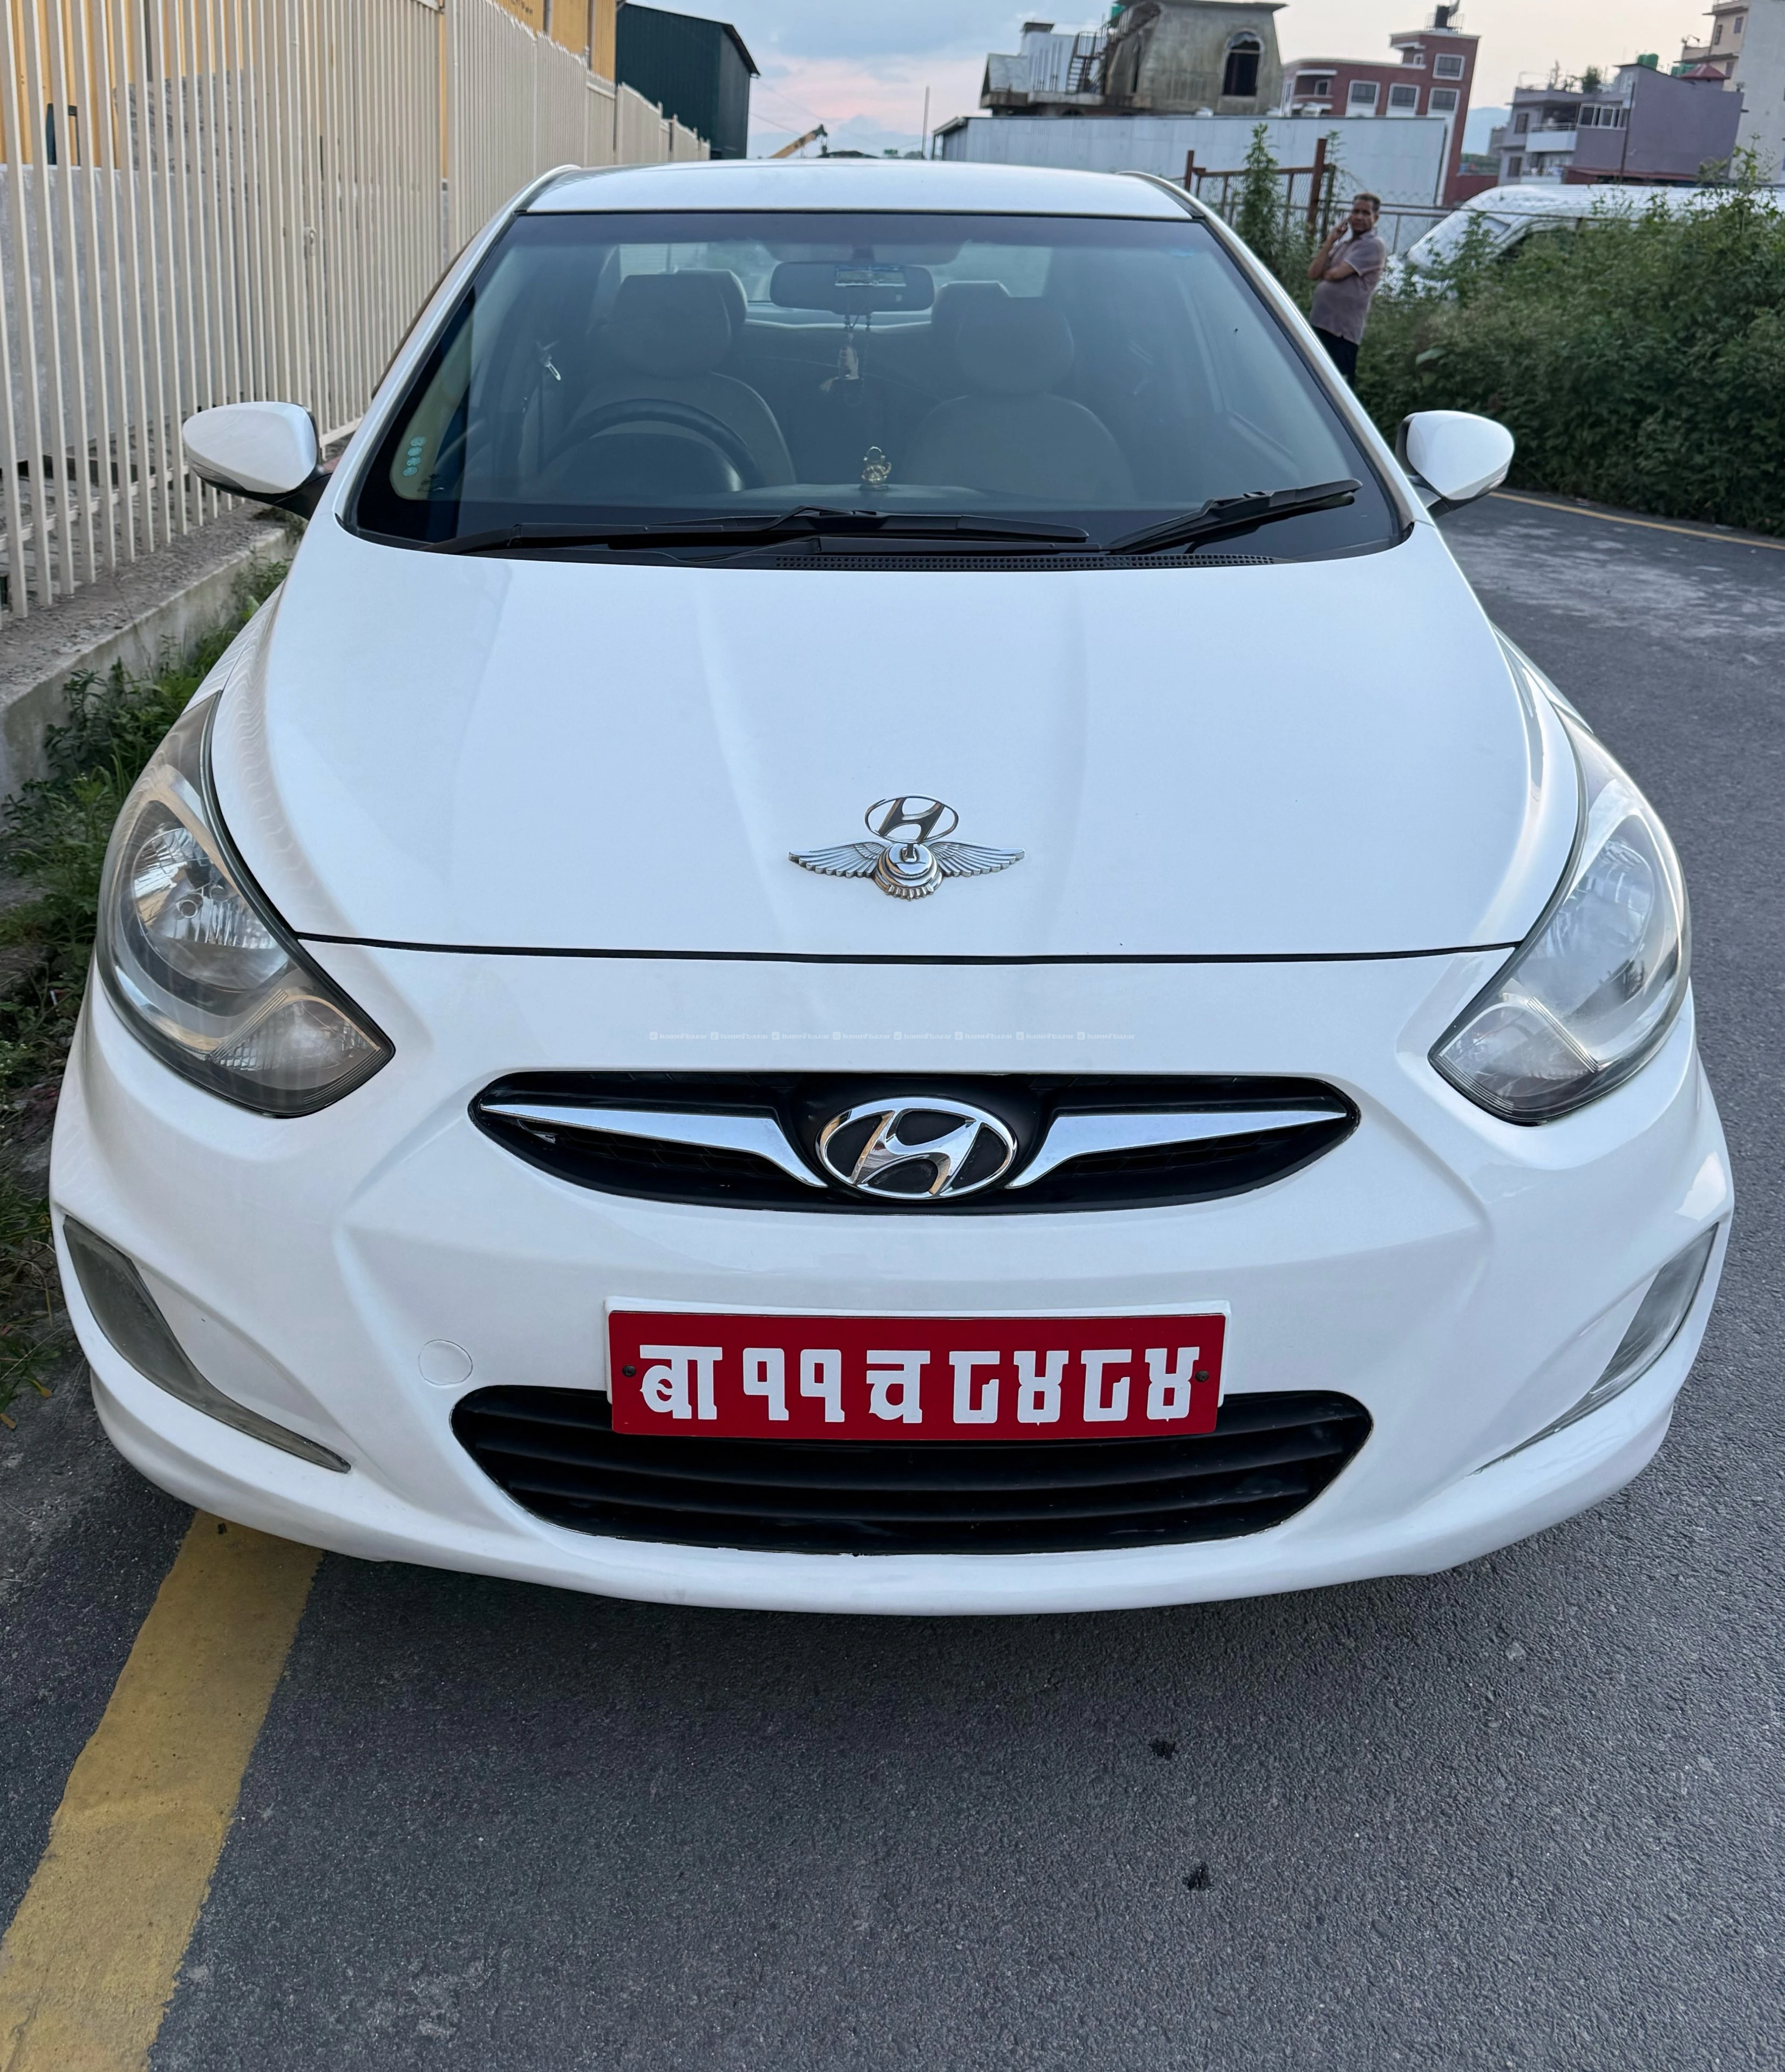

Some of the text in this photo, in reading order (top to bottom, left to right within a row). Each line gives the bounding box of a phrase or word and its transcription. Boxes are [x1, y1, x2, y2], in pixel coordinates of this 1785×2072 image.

[640, 1345, 722, 1420] बा
[743, 1348, 844, 1422] ११
[867, 1351, 930, 1423] च
